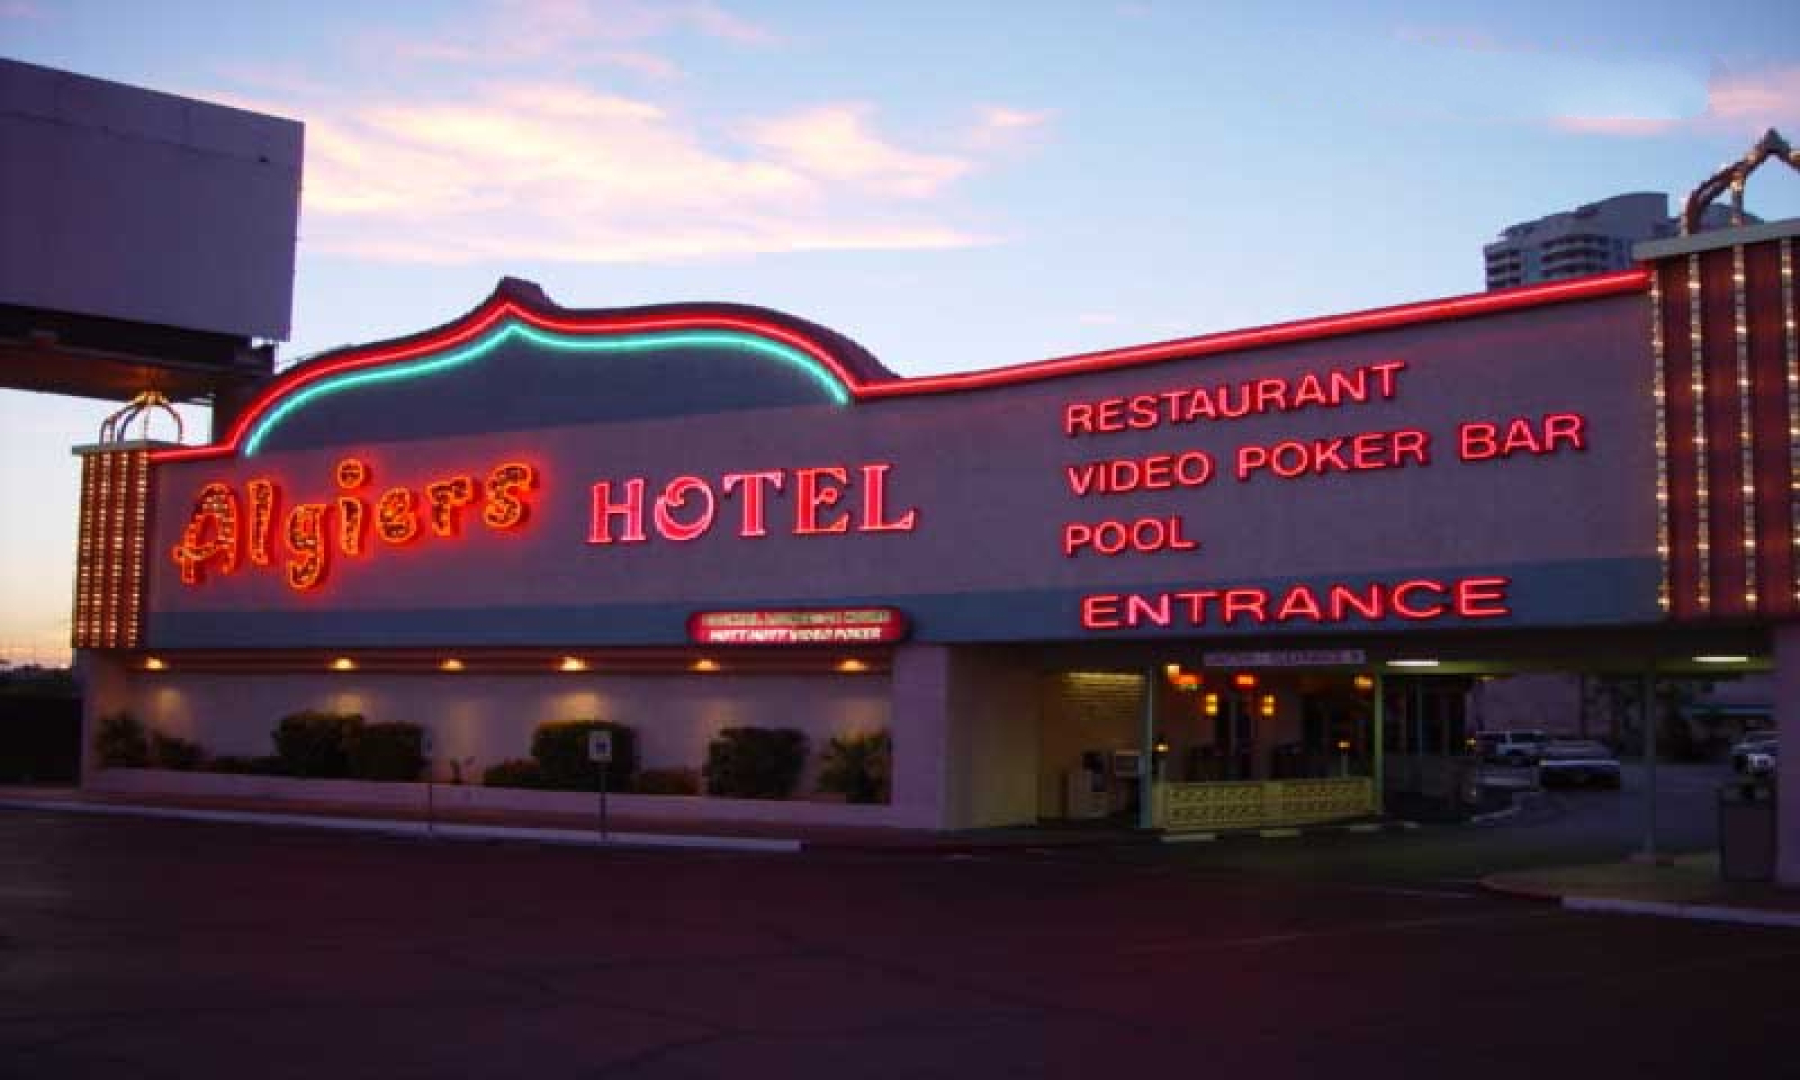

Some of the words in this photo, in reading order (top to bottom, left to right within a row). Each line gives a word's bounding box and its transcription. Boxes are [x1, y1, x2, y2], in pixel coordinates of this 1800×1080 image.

[1064, 361, 1405, 436] RESTAURANT
[1067, 452, 1213, 496] VIDEO
[1237, 430, 1430, 480] POKER
[1459, 412, 1586, 461] BAR
[172, 456, 538, 592] Algiers
[586, 464, 918, 544] HOTEL
[1064, 515, 1198, 556] POOL
[1082, 577, 1510, 630] ENTRANCE
